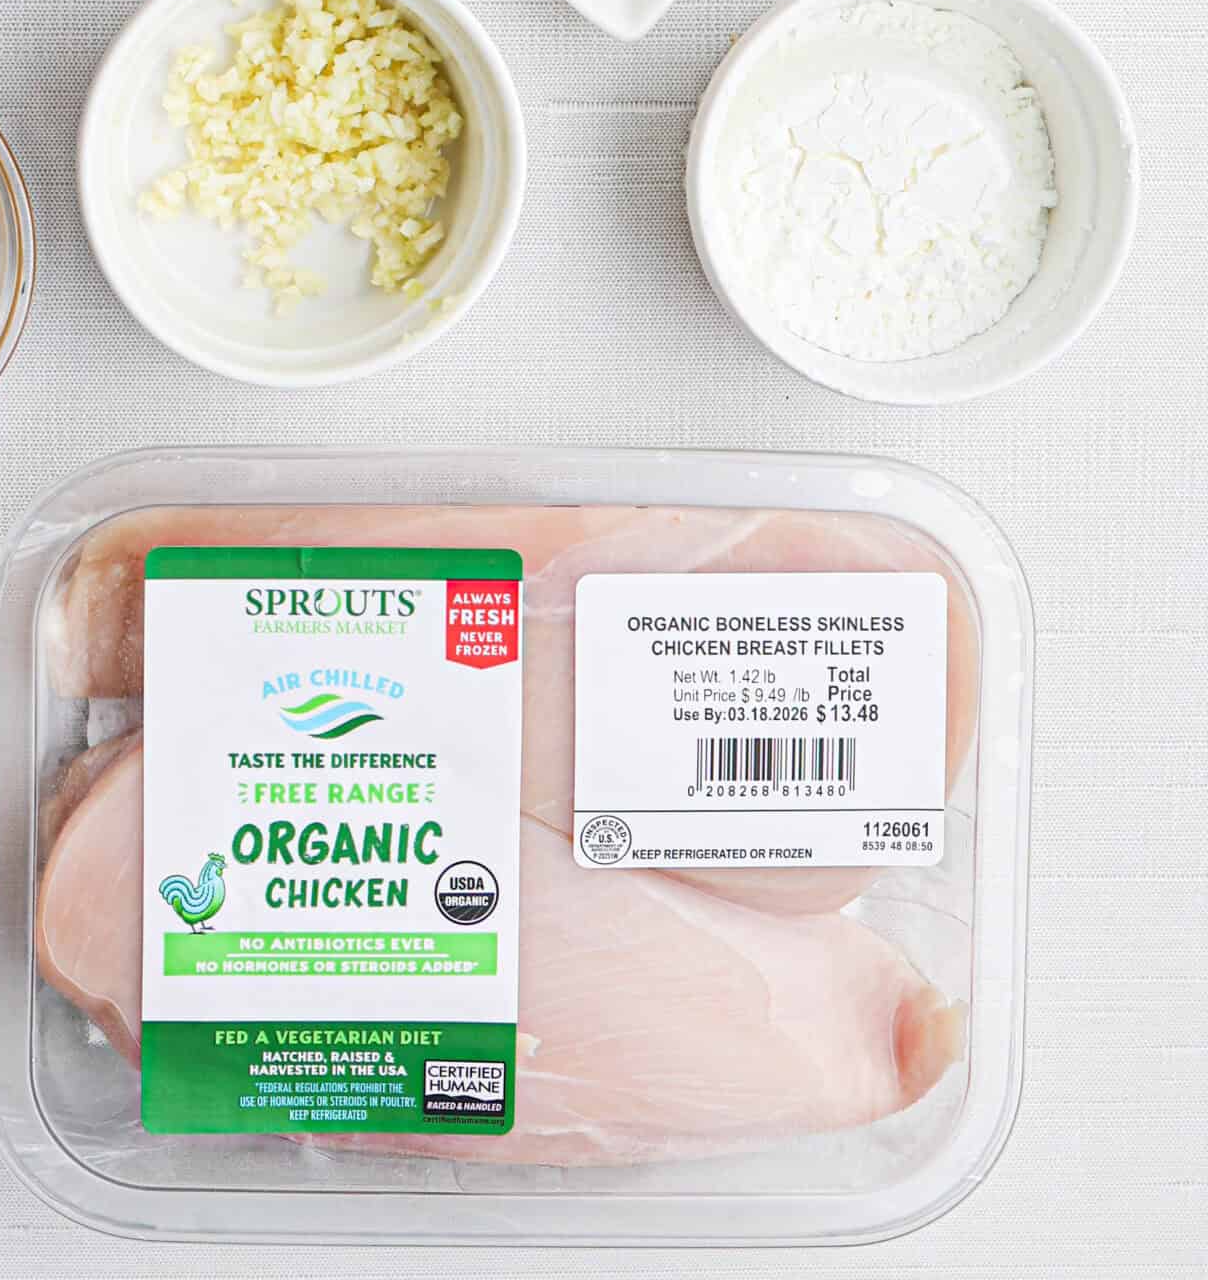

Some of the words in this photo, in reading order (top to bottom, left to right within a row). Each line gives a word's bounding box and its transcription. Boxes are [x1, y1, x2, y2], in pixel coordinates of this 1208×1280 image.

[453, 593, 511, 605] ALWAYS
[448, 609, 515, 625] FRESH
[627, 616, 710, 631] ORGANIC
[716, 616, 812, 631] BONELESS
[817, 616, 905, 631] SKINLESS
[253, 621, 331, 634] FARMERS
[336, 621, 408, 634] MARKET
[460, 631, 503, 643] NEVER
[456, 645, 507, 656] FROZEN
[651, 640, 731, 655] CHICKEN
[737, 640, 808, 655] BREAST
[814, 640, 884, 655] FILLETS
[673, 670, 696, 683] Net
[700, 670, 721, 683] Wt.
[730, 669, 760, 683] 1.42
[763, 669, 776, 683] lb
[827, 666, 870, 682] Total
[261, 673, 302, 700] AIR
[309, 669, 405, 699] CHILLED
[673, 689, 700, 702] Unit
[703, 689, 736, 702] Price
[754, 689, 786, 702] 9.49
[792, 688, 810, 702] /lb
[828, 685, 872, 701] Price
[673, 708, 700, 721] Use
[228, 753, 285, 769] TASTE
[291, 753, 324, 769] THE
[331, 753, 437, 769] DIFFERENCE
[255, 783, 317, 804] FREE
[328, 783, 420, 804] RANGE
[585, 819, 627, 839] INSPECTED
[863, 822, 929, 837] 1126061
[231, 820, 443, 866] ORGANIC
[598, 834, 615, 843] U.S.
[862, 841, 886, 851] 8539
[632, 849, 662, 860] KEEP
[664, 848, 747, 860] REFRIGERATED
[749, 848, 766, 860] OR
[769, 848, 813, 860] FROZEN
[449, 876, 485, 892] USDA
[265, 877, 409, 909] CHICKEN
[444, 894, 489, 908] ORGANIC
[239, 937, 265, 952] NO
[271, 937, 385, 952] ANTIBIOTICS
[391, 937, 436, 952] EVER
[195, 960, 219, 973] NO
[223, 960, 309, 973] HORMONES
[313, 960, 336, 973] OR
[339, 960, 417, 973] STEROIDS
[215, 1031, 247, 1045] FED
[255, 1031, 269, 1045] A
[275, 1031, 394, 1045] VEGETARIAN
[400, 1031, 442, 1045] DIET
[263, 1051, 327, 1064] HATCHED,
[331, 1051, 380, 1062] RAISED
[384, 1051, 395, 1063] &
[249, 1065, 328, 1076] HARVESTED
[332, 1065, 345, 1076] IN
[350, 1065, 375, 1076] THE
[379, 1065, 407, 1076] USA
[428, 1066, 502, 1079] CERTIFIED
[295, 1082, 348, 1093] REGULATIONS
[350, 1082, 386, 1093] PROHIBIT
[389, 1083, 403, 1093] THE
[430, 1080, 500, 1093] HUMANE
[240, 1096, 255, 1107] USE
[257, 1096, 268, 1107] OF
[270, 1096, 313, 1107] HORMONES
[317, 1096, 327, 1107] OR
[330, 1096, 367, 1107] STEROIDS
[370, 1096, 378, 1107] IN
[427, 1101, 456, 1110] RAISED
[456, 1101, 463, 1110] &
[464, 1102, 502, 1111] HANDLED
[289, 1109, 309, 1121] KEEP
[311, 1109, 367, 1121] REFRIGERATED
